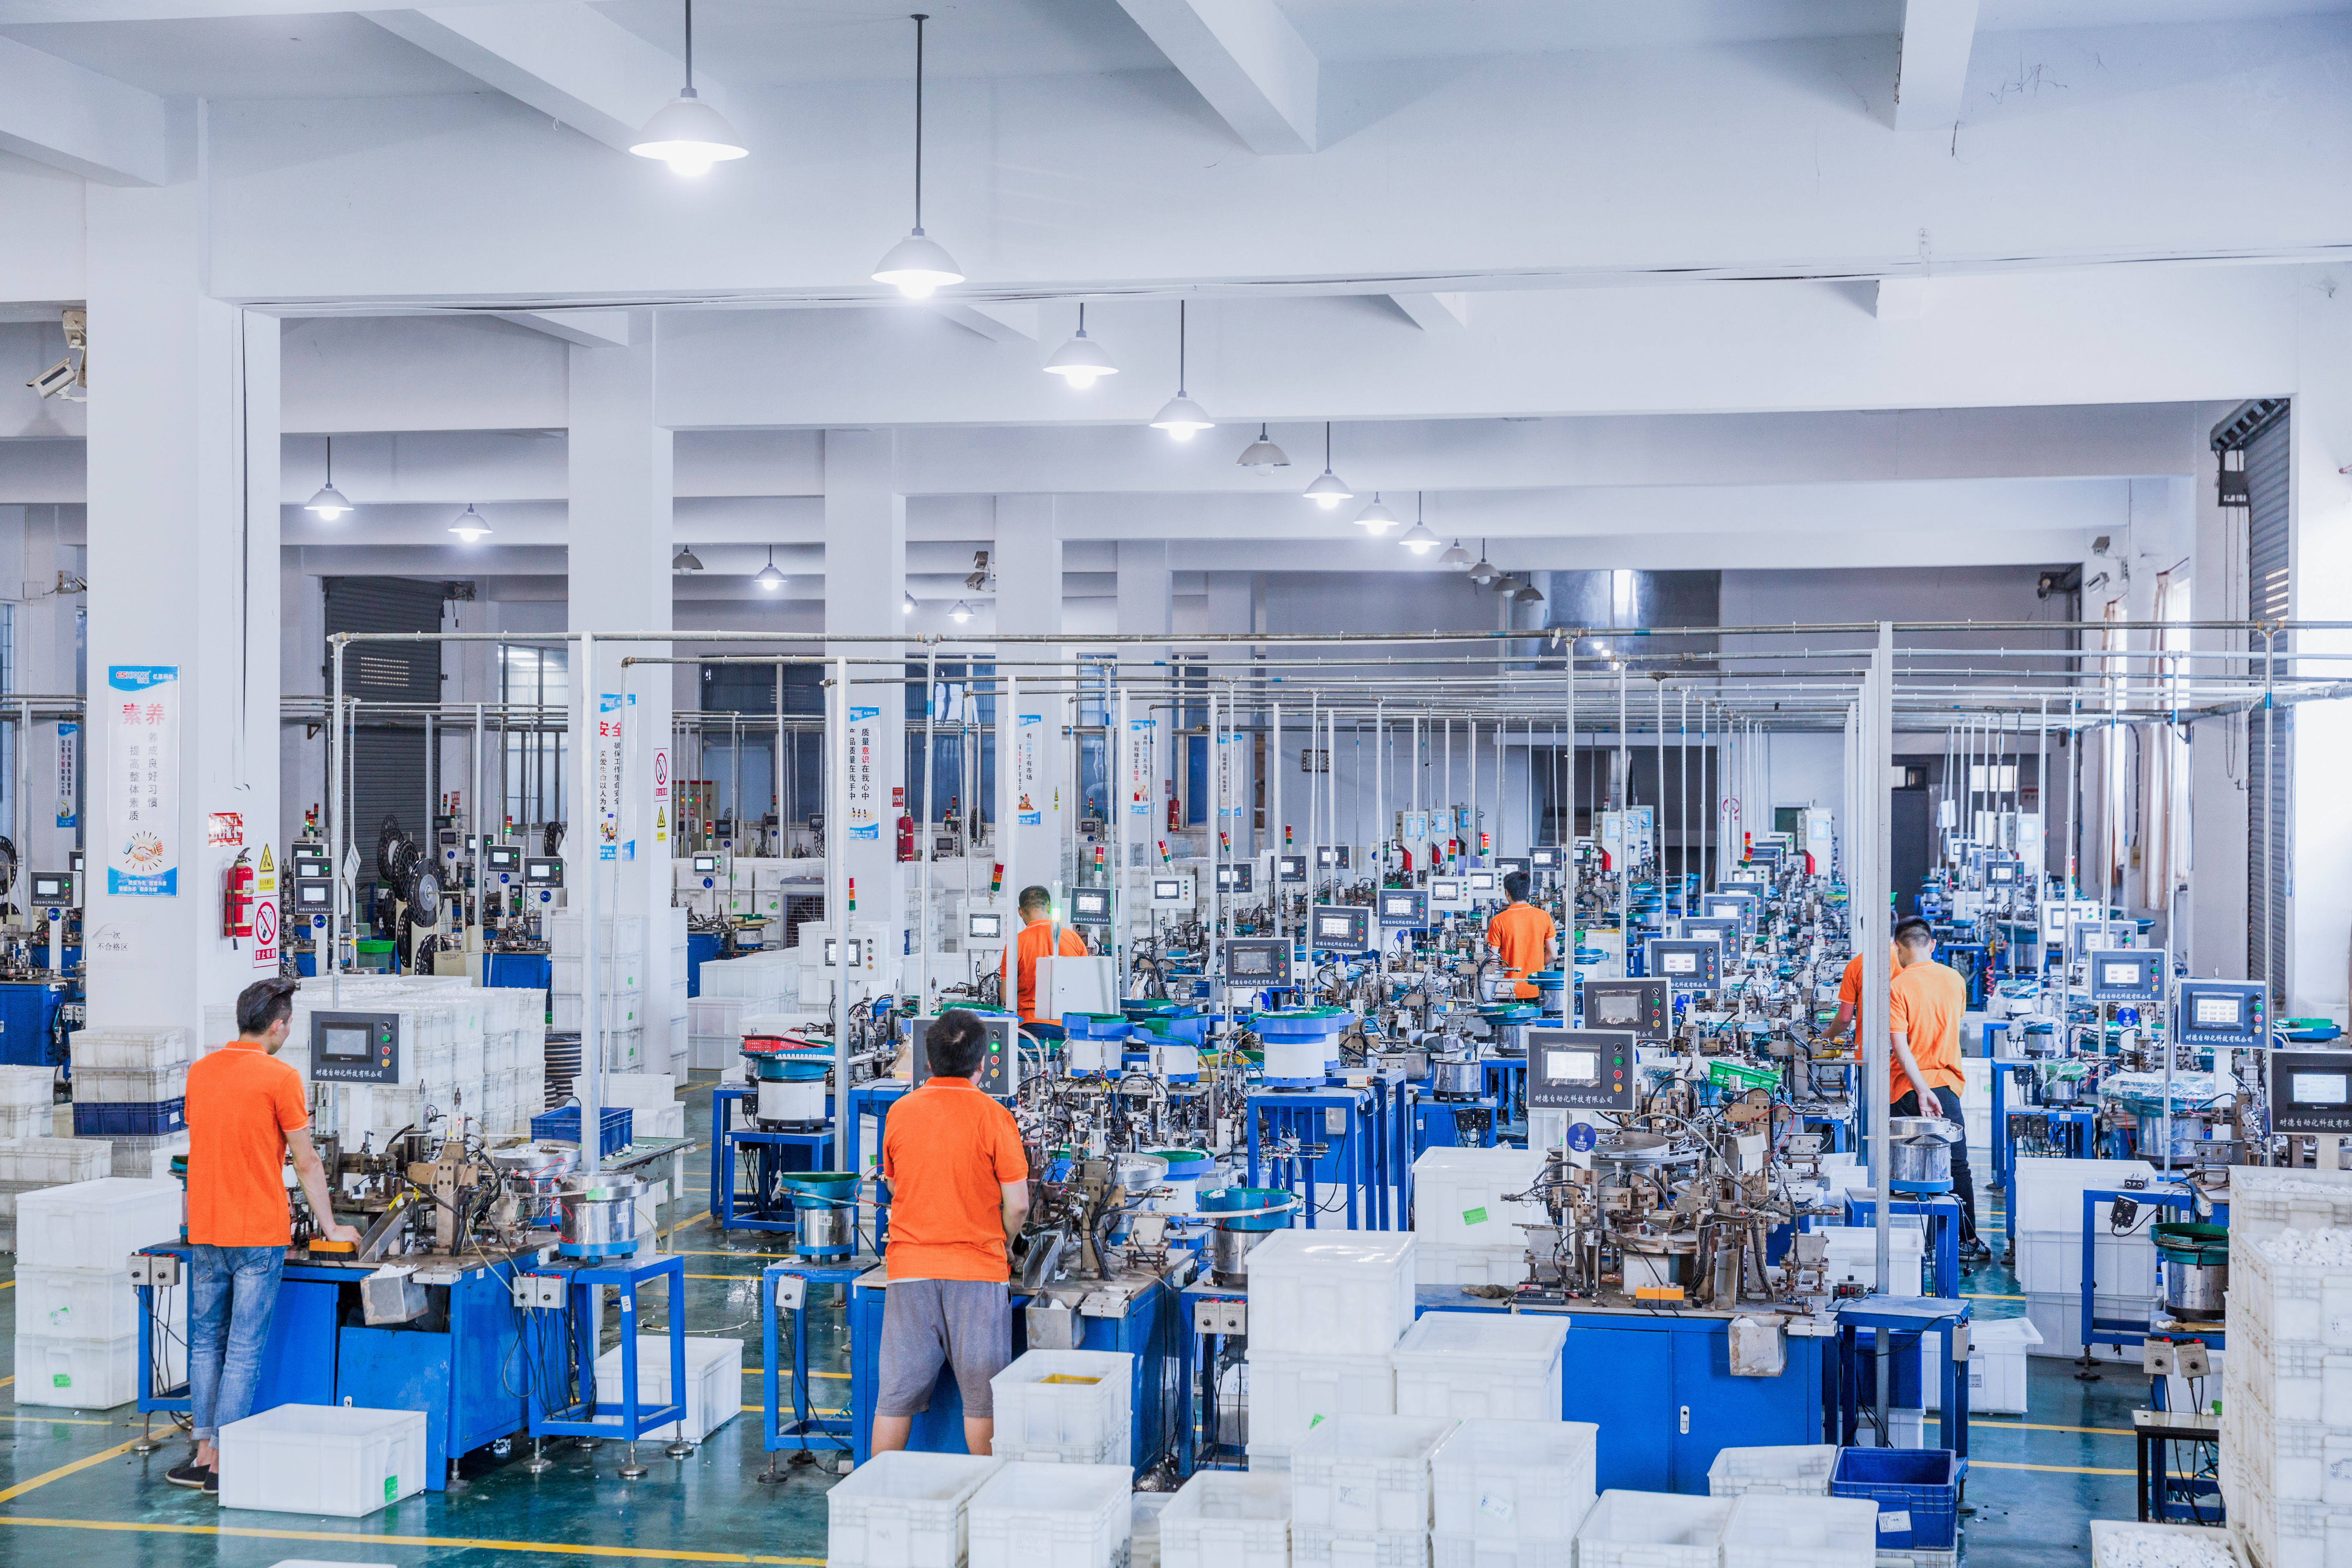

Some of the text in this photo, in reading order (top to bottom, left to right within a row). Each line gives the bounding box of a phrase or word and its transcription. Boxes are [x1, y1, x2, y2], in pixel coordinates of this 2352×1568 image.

[122, 703, 165, 725] 素养
[148, 732, 158, 807] 养成良好习惯
[129, 746, 140, 820] 提高整体素质
[104, 931, 120, 939] 一次
[256, 949, 275, 959] 禁止吸烟
[2185, 1034, 2253, 1043] 耐德自动化科技有限公司
[316, 1068, 382, 1078] 耐德自动化科技有限公司
[1535, 1094, 1613, 1104] 耐德自动化科技有限公司
[2279, 1118, 2352, 1129] 耐德自动化科技有限
